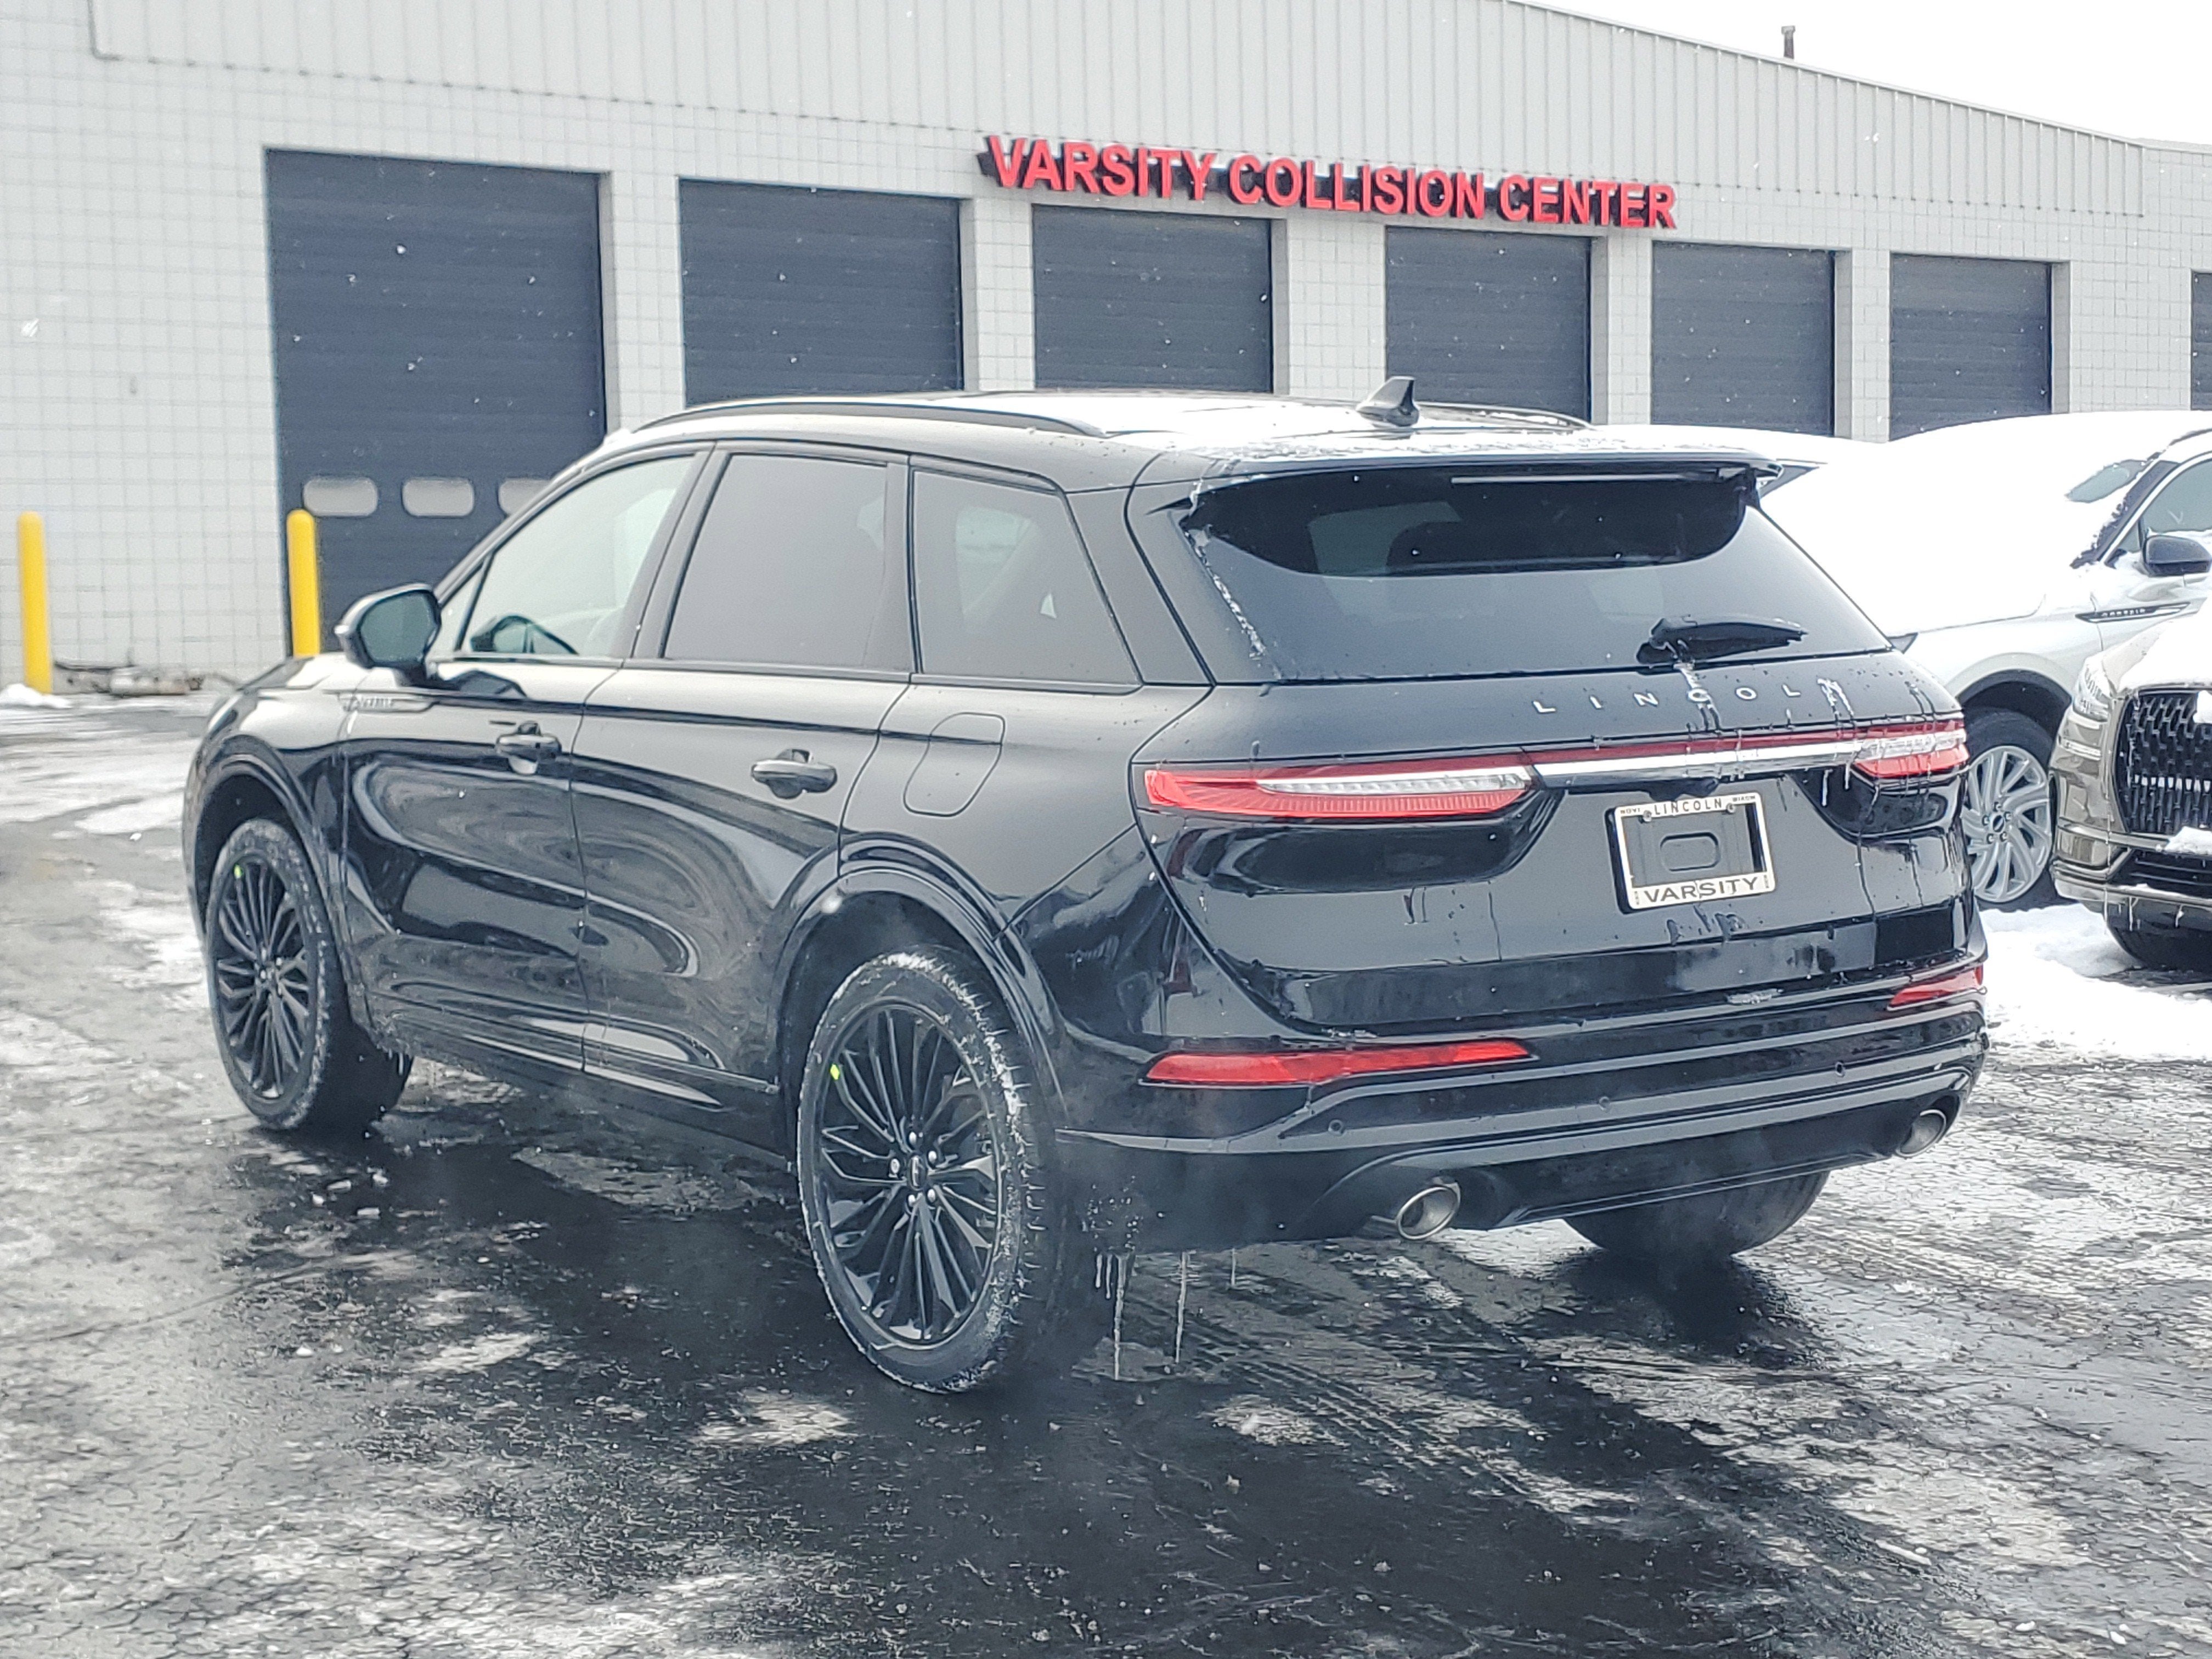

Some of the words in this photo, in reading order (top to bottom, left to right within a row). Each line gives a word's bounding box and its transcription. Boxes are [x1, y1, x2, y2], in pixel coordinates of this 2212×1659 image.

[989, 135, 1218, 200] VARSITY
[1229, 154, 1485, 219] COLLISION
[1499, 174, 1677, 229] CENTER
[1654, 798, 1722, 815] LINCOLN
[1644, 876, 1758, 902] VARSITY
